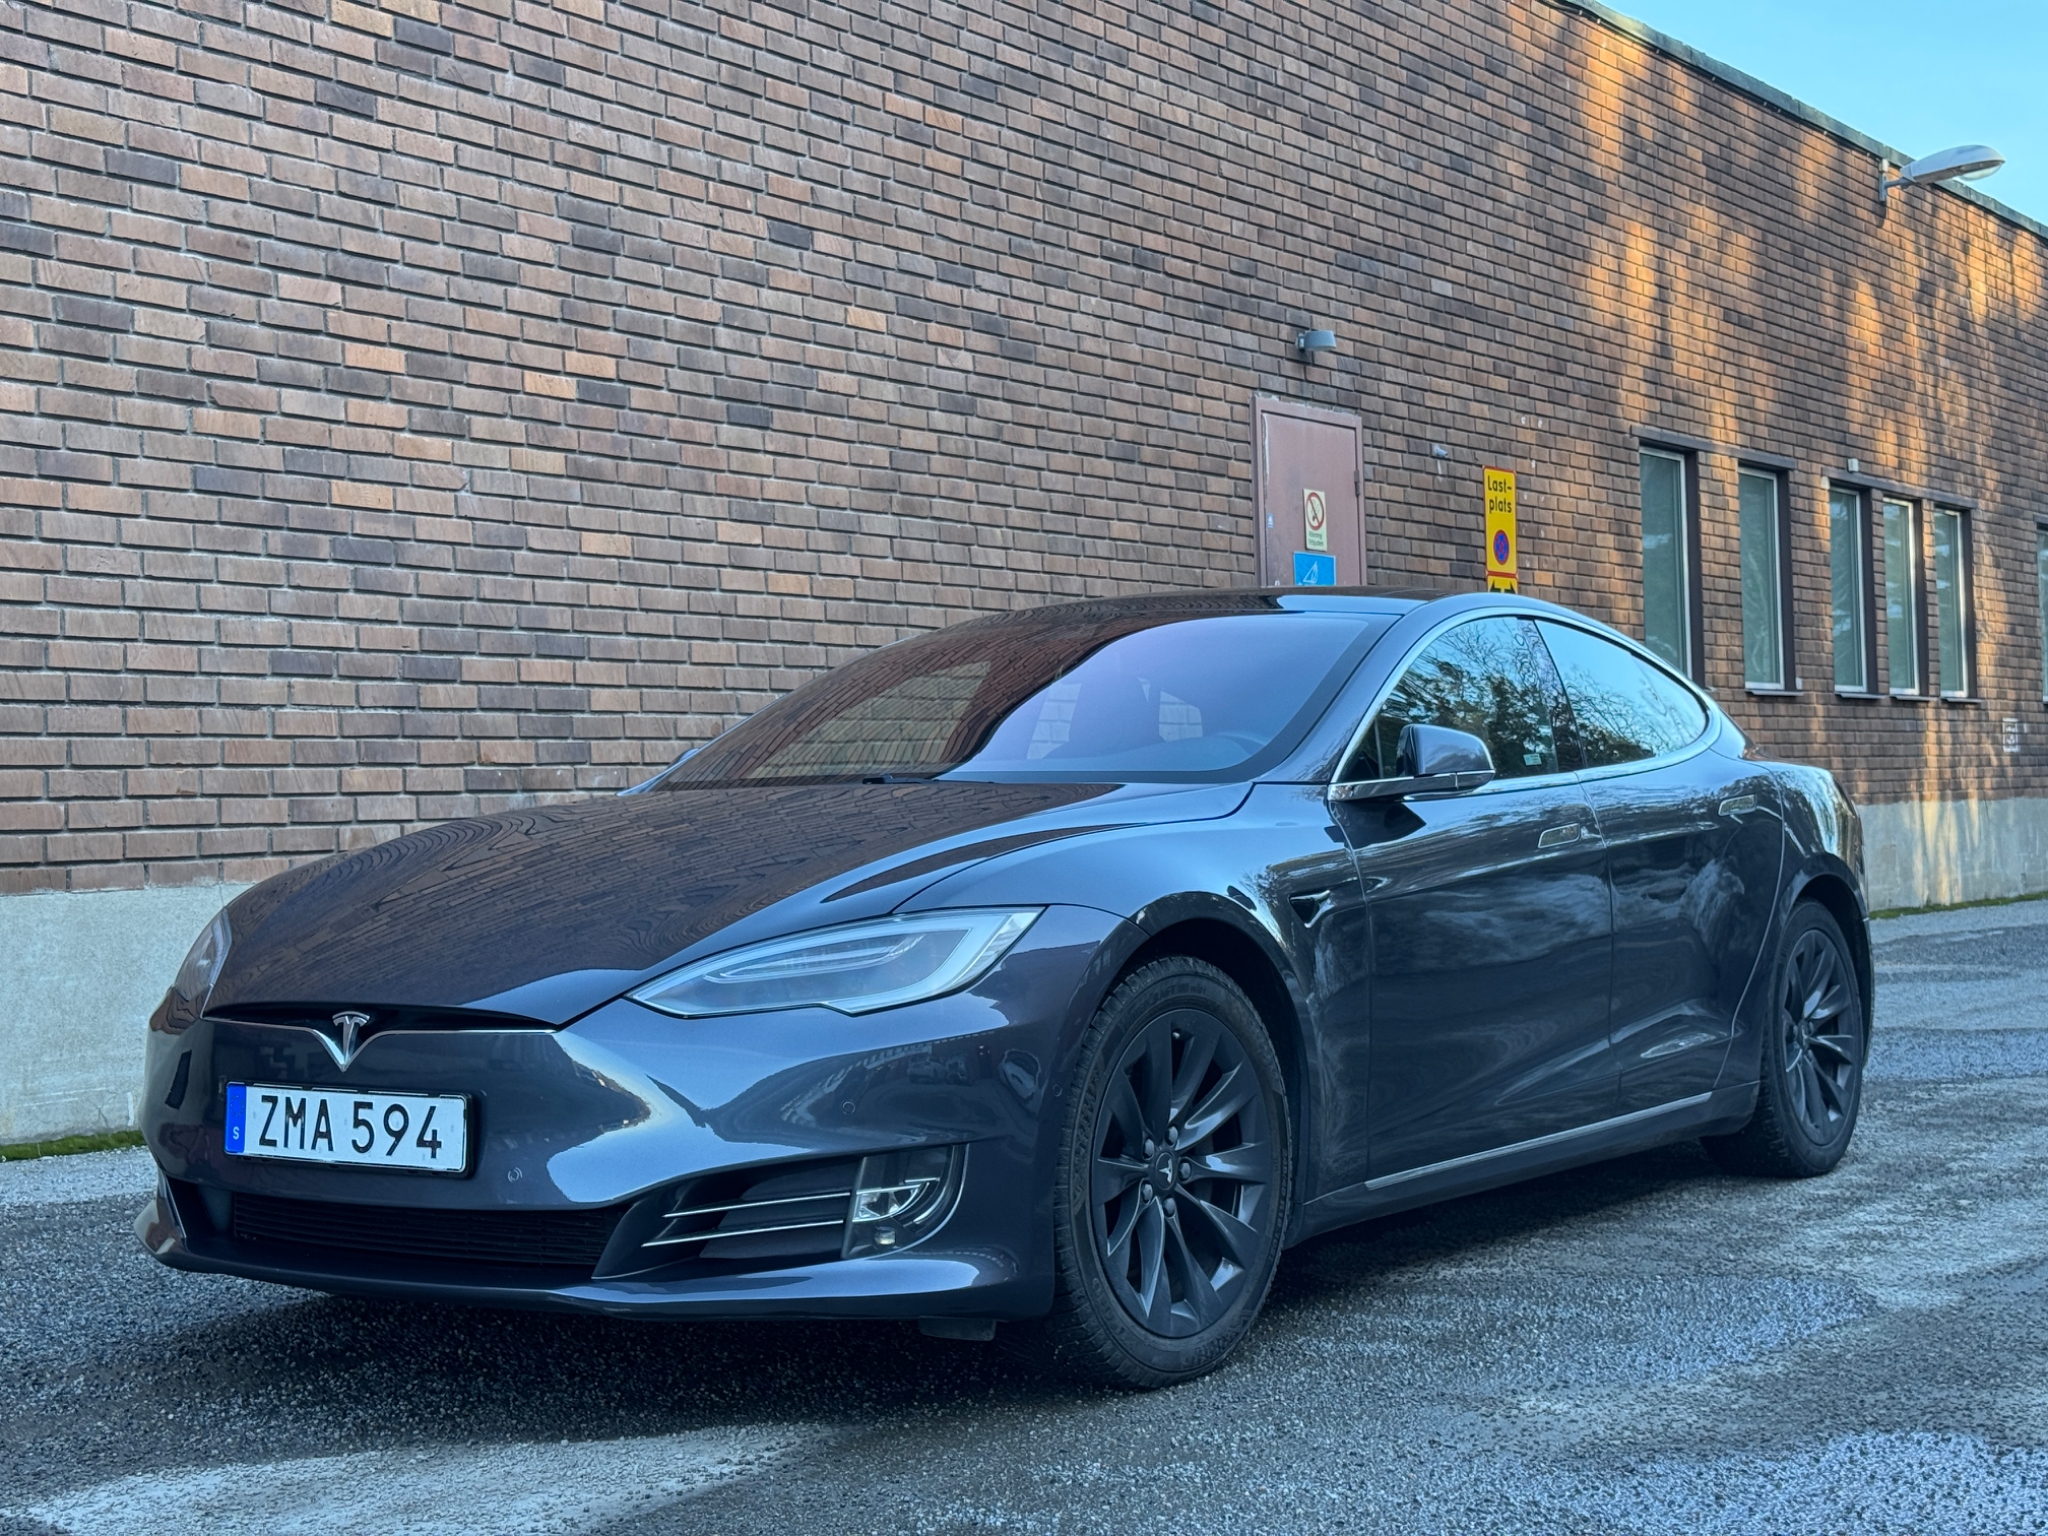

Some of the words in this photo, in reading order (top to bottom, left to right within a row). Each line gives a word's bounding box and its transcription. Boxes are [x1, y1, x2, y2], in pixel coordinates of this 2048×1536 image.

[1488, 475, 1512, 493] Last-
[1489, 496, 1512, 514] plats
[232, 1126, 240, 1140] S
[258, 1094, 334, 1152] ZMA
[351, 1100, 442, 1159] 594
